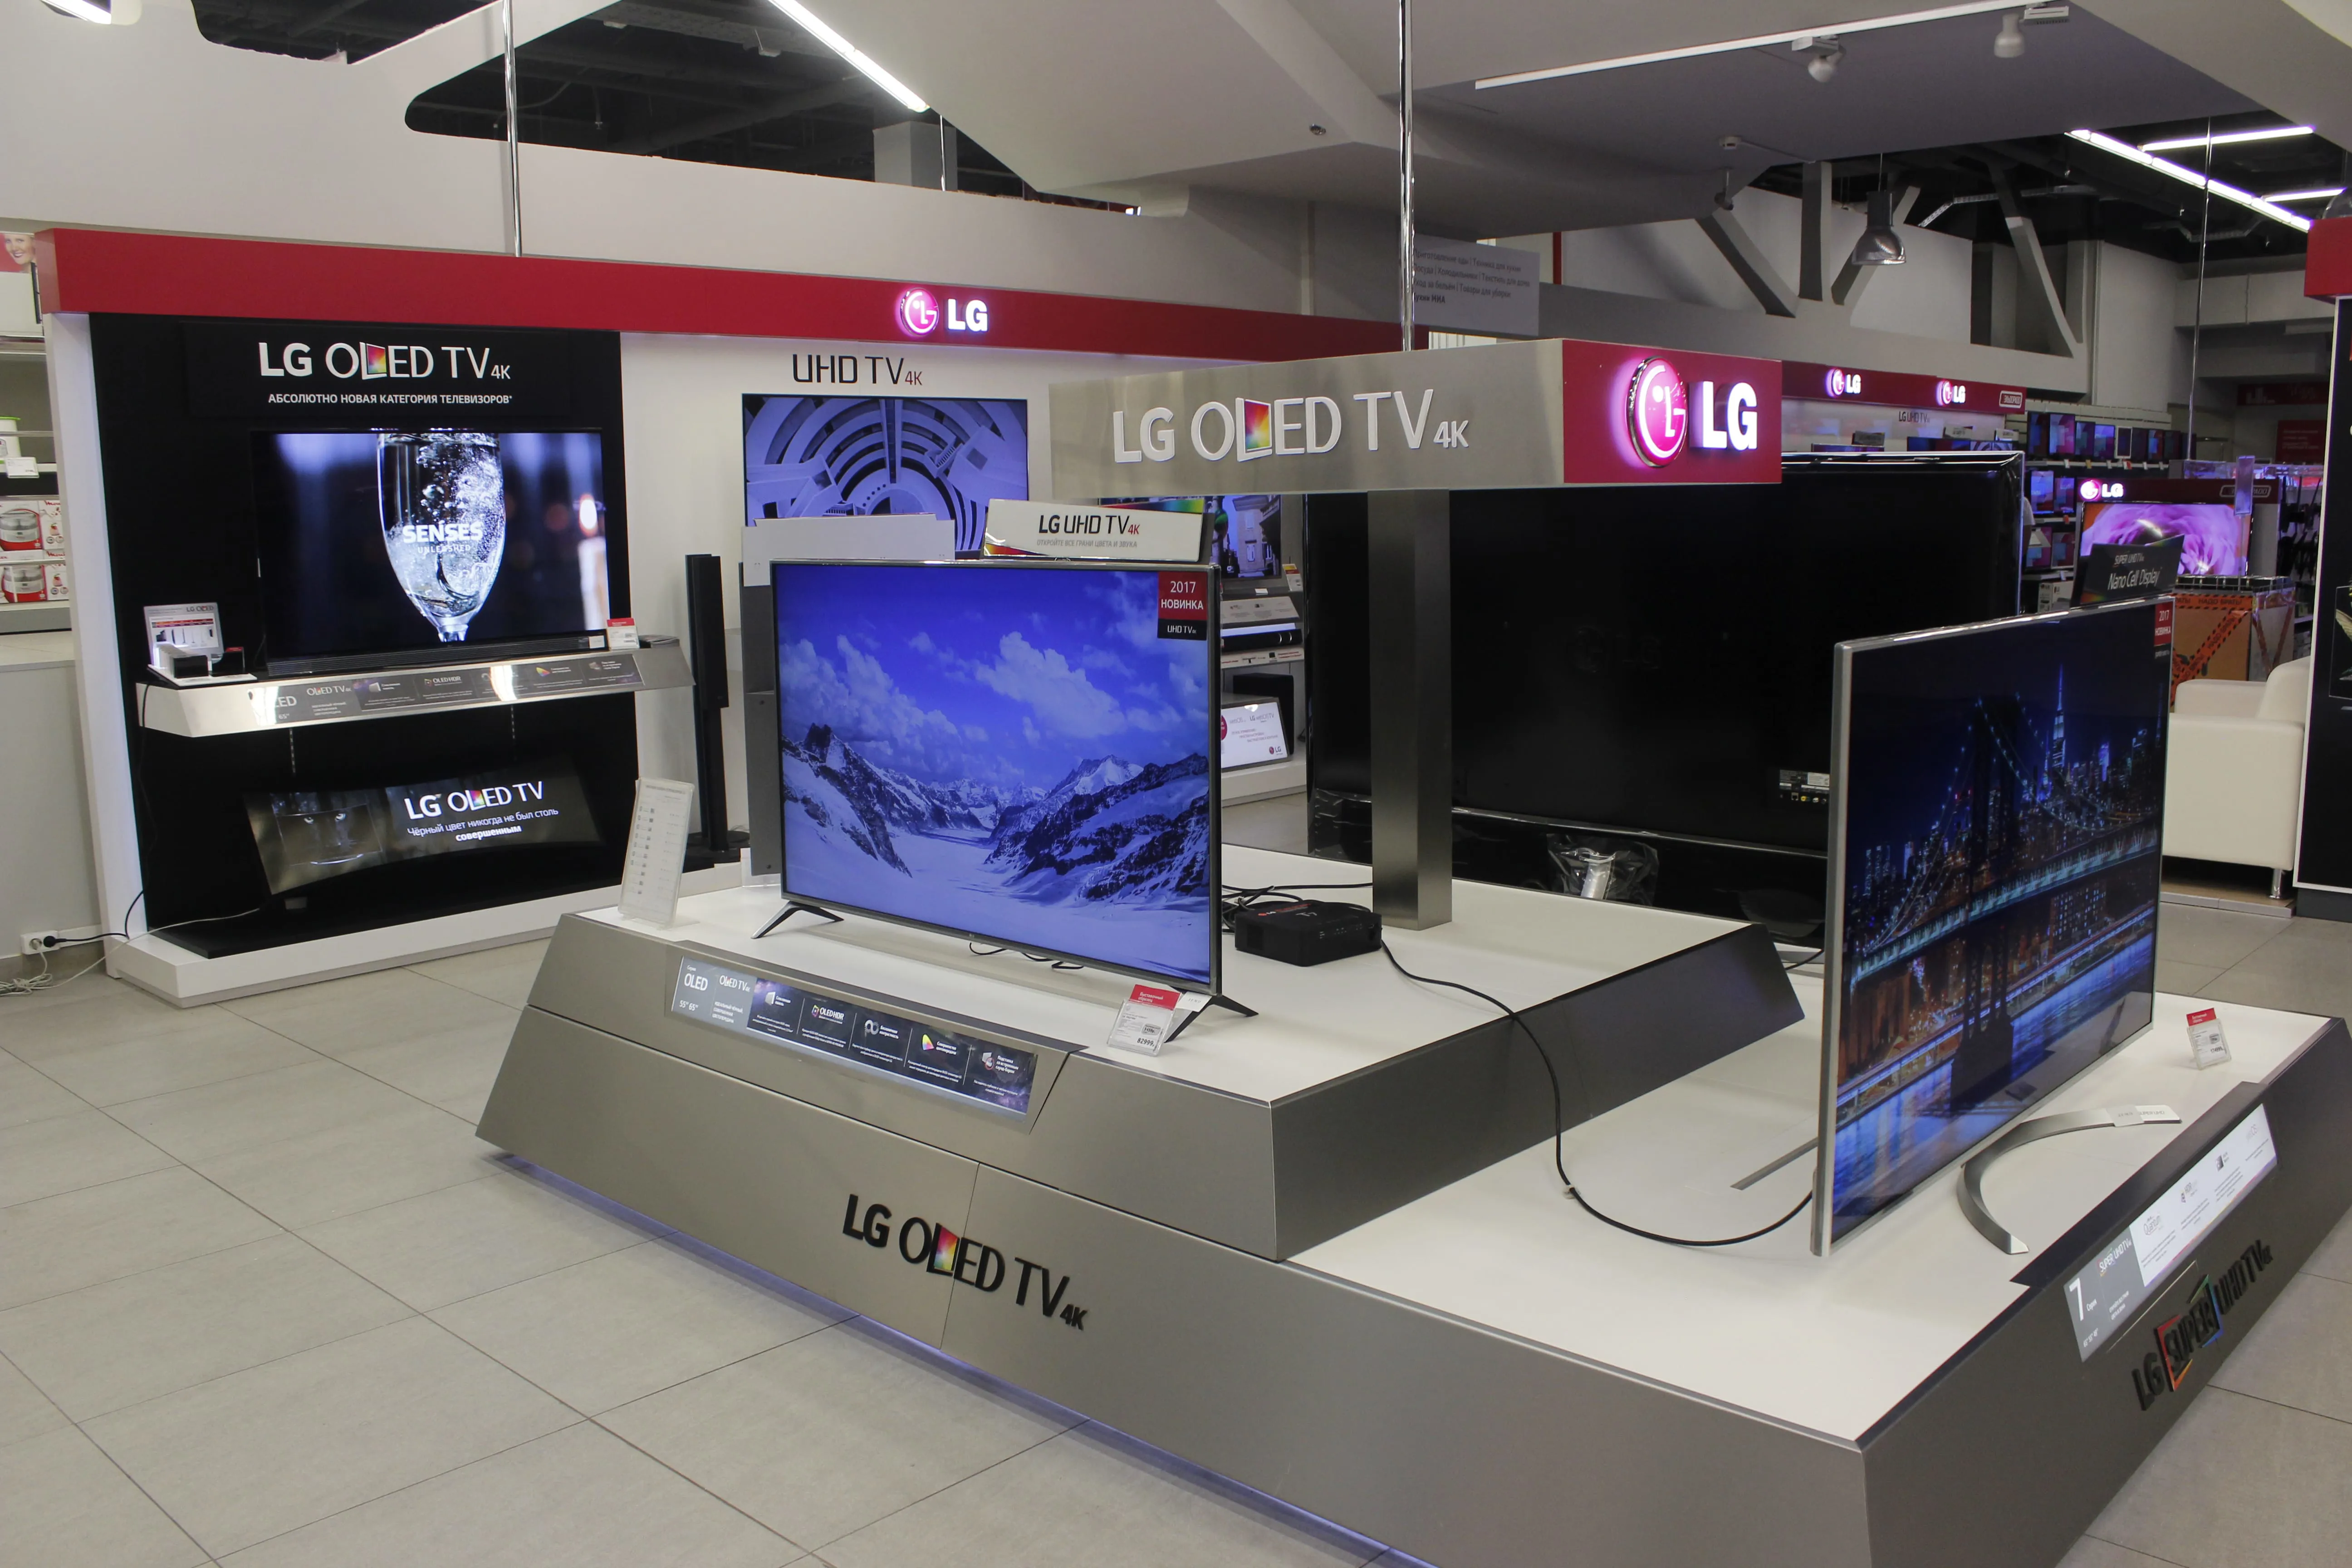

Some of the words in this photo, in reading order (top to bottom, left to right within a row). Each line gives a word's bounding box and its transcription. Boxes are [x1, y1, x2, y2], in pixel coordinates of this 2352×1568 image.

[948, 299, 988, 332] LG
[259, 342, 312, 377] LG
[325, 342, 434, 380] OLED
[441, 346, 490, 379] TV
[491, 365, 510, 379] 4K
[793, 354, 858, 384] UHD
[865, 357, 904, 385] TV
[905, 371, 922, 386] 4K
[1846, 374, 1861, 393] LG
[269, 394, 338, 404] АБСОЛЮТНО
[341, 394, 377, 404] НОВАЯ
[380, 395, 437, 404] КАТЕГОРИЯ
[1953, 385, 1966, 403] LG
[1701, 380, 1758, 451] LG
[1899, 411, 1906, 421] LG
[1113, 407, 1175, 463] LG
[1191, 396, 1342, 462] OLED
[1353, 389, 1434, 451] TV
[1433, 420, 1470, 449] 4K
[2102, 483, 2124, 498] LG
[402, 521, 484, 543] SENSES
[1039, 515, 1060, 534] LG
[1064, 515, 1101, 534] UHD
[1106, 515, 1129, 534] TV
[1128, 524, 1140, 535] 4K
[1037, 538, 1063, 547] ОТКРОЙТЕ
[1171, 581, 1196, 593] 2017
[2107, 573, 2127, 590] Nano
[2127, 570, 2138, 587] Cell
[2139, 568, 2161, 588] Display
[1161, 598, 1203, 610] НОВИНКА
[2159, 610, 2170, 622] 2017
[2155, 626, 2171, 636] НОВИНКА
[307, 686, 333, 696] OLED
[334, 685, 345, 693] TV
[404, 794, 442, 819] LG
[447, 786, 512, 812] OLED
[512, 781, 543, 802] TV
[407, 823, 444, 837] Чёрный
[446, 822, 466, 831] цвет
[467, 817, 503, 828] никогда
[504, 814, 515, 823] не
[516, 811, 534, 821] был
[534, 808, 559, 818] столь
[456, 825, 521, 841] совершенным
[684, 973, 708, 991] OLED
[720, 975, 737, 988] OLED
[738, 980, 747, 991] TV
[820, 1007, 833, 1017] OLED
[833, 1011, 844, 1020] HDR
[843, 1194, 892, 1248] LG
[899, 1217, 1005, 1292] OLED
[1014, 1257, 1070, 1318] TV
[1059, 1303, 1088, 1331] 4K
[2099, 1252, 2114, 1272] SUPER
[2069, 1278, 2084, 1321] 7
[2132, 1352, 2165, 1411] LG
[2164, 1296, 2216, 1368] SUPER
[2213, 1260, 2249, 1315] UHD
